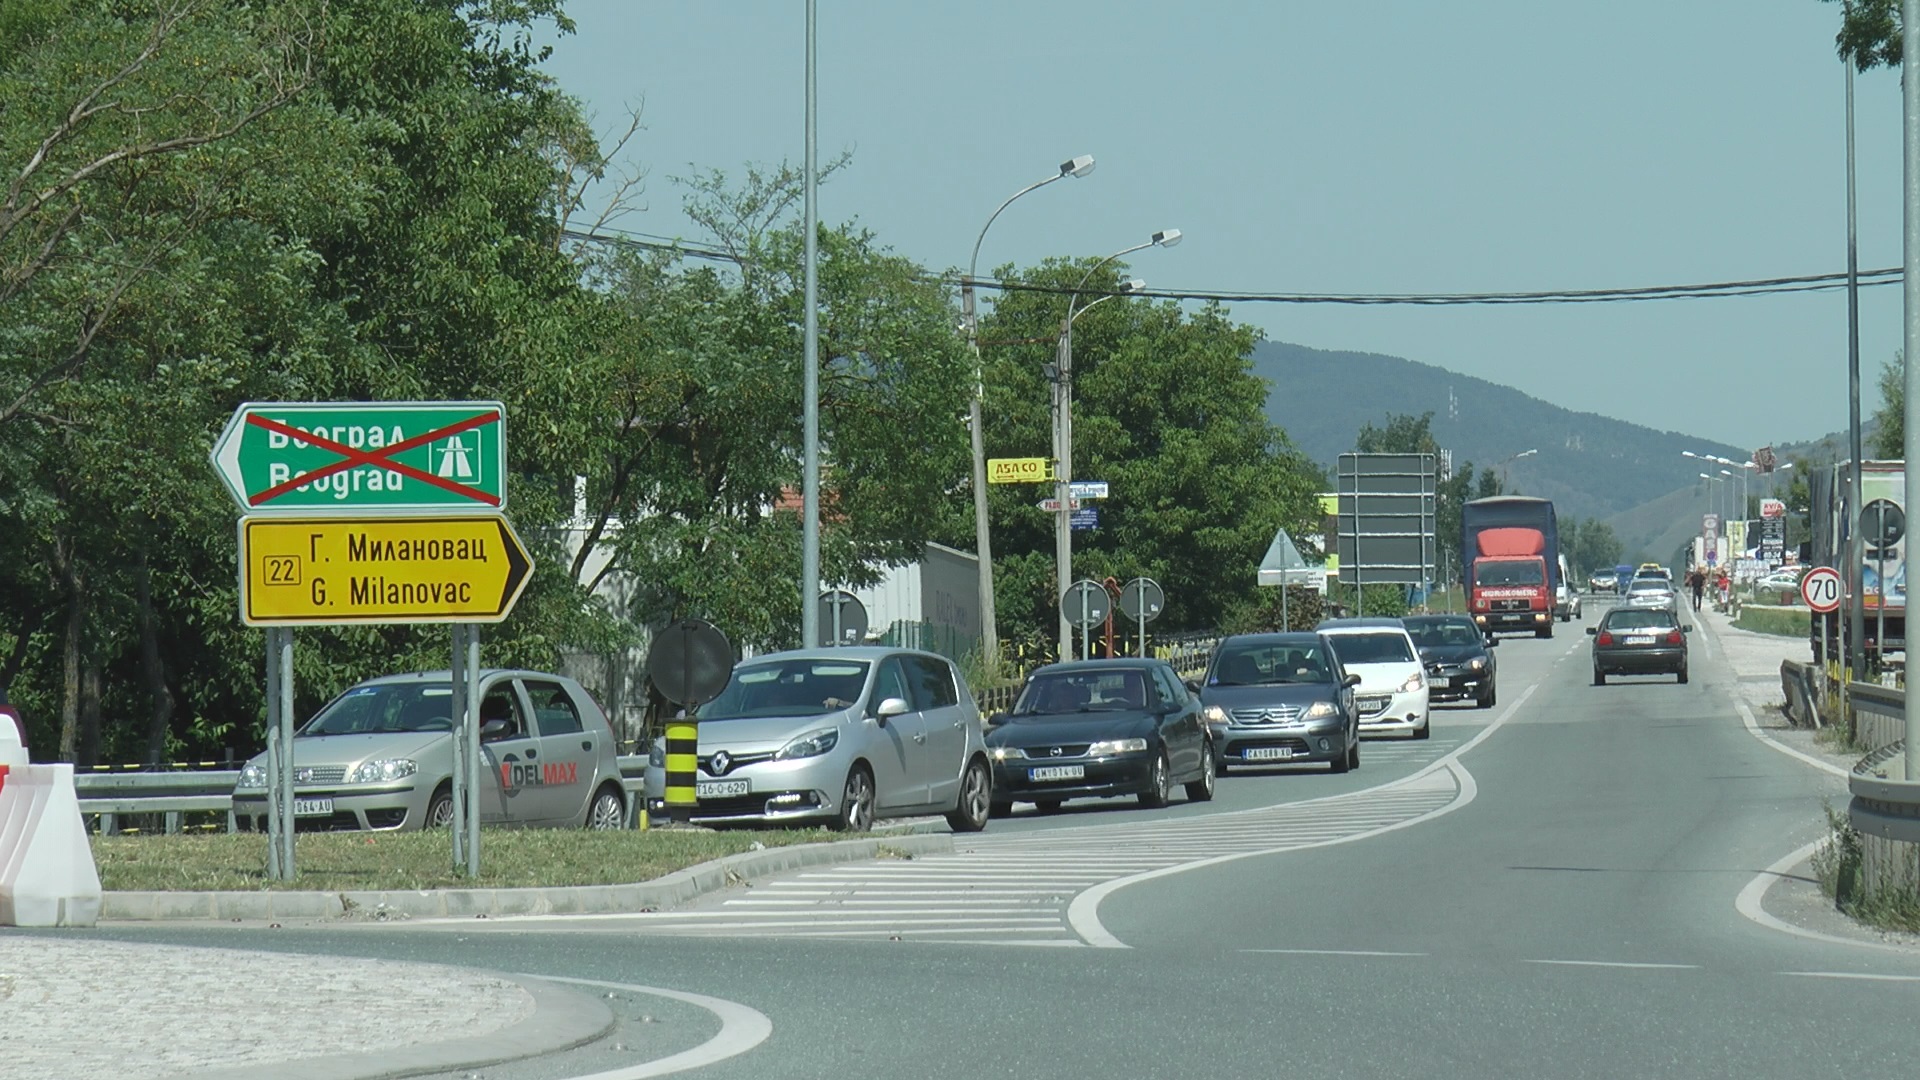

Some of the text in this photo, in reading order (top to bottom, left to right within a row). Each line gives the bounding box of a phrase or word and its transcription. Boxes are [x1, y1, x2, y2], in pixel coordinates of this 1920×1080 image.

[269, 462, 404, 500] Beograd
[311, 533, 487, 562] Г. Милановац
[270, 559, 294, 581] 22
[312, 576, 471, 606] G. Milanovac
[1811, 579, 1836, 600] 70
[513, 762, 577, 785] DELMAX
